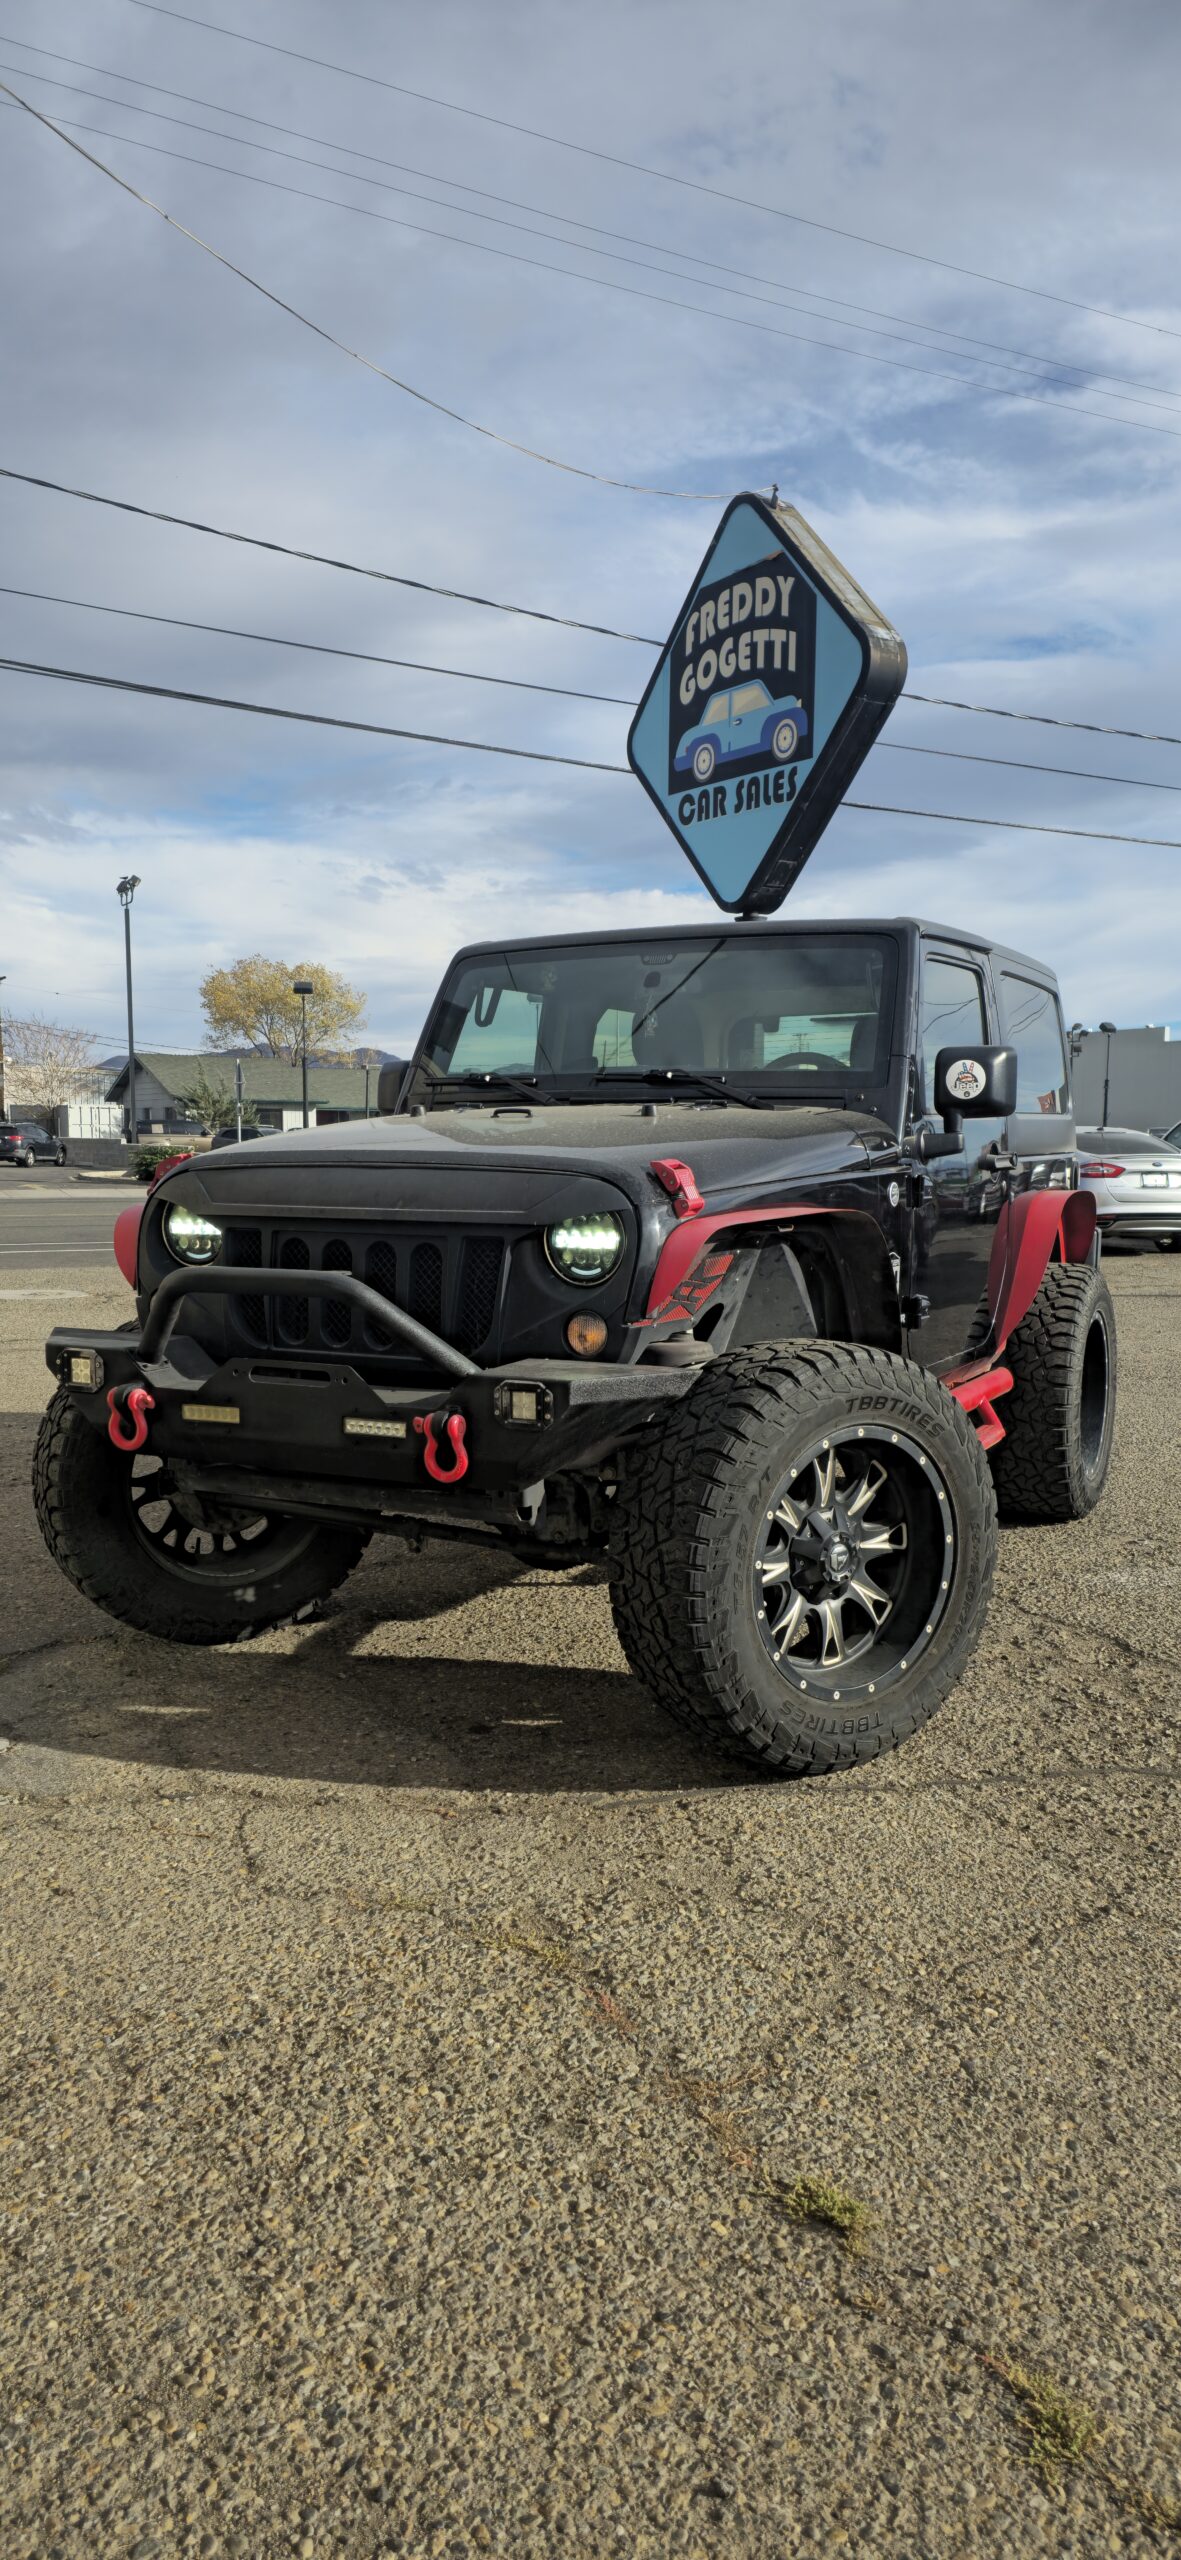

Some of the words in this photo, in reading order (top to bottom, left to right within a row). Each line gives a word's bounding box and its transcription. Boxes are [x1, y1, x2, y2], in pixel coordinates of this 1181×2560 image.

[685, 576, 795, 657] FREDDY
[679, 628, 797, 706] GOGETTI
[677, 785, 727, 827] CAR
[734, 765, 798, 815] SALES
[952, 1080, 980, 1092] Jeep
[845, 1395, 946, 1439] TBBTIRES
[778, 1700, 884, 1736] TBBTIRES
